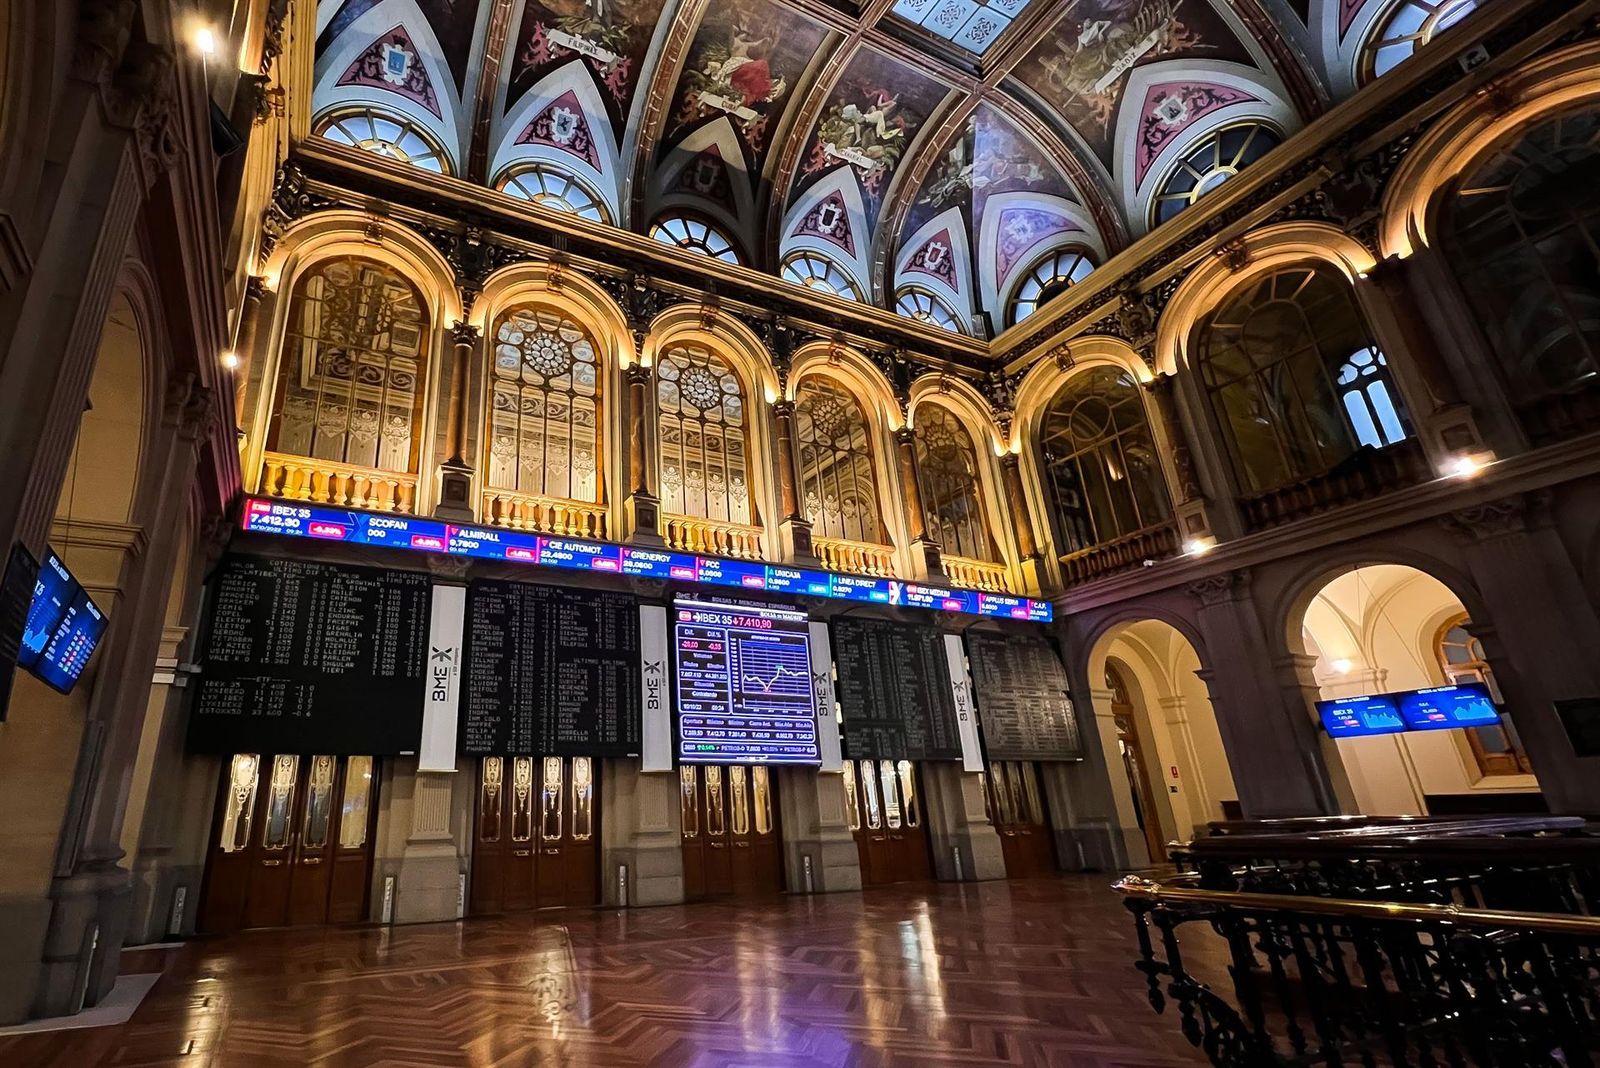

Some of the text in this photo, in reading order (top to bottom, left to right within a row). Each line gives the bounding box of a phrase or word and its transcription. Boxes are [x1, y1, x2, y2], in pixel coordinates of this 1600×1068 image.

[273, 505, 297, 516] IBEX
[298, 508, 311, 518] 35
[251, 513, 301, 528] 7.412,30
[369, 518, 408, 530] SCOFAN
[459, 529, 500, 543] ALMIRALL
[549, 541, 603, 555] CIE AUTOMOT.
[630, 551, 671, 563] GRENERGY
[705, 560, 720, 569] FCC
[774, 569, 801, 579] UNICAJA
[855, 579, 877, 588] DIRECT
[700, 613, 721, 624] IBEX
[721, 615, 732, 625] 35
[432, 666, 448, 702] BME
[647, 678, 659, 710] BME
[817, 687, 828, 717] BME
[956, 695, 968, 722] BME
